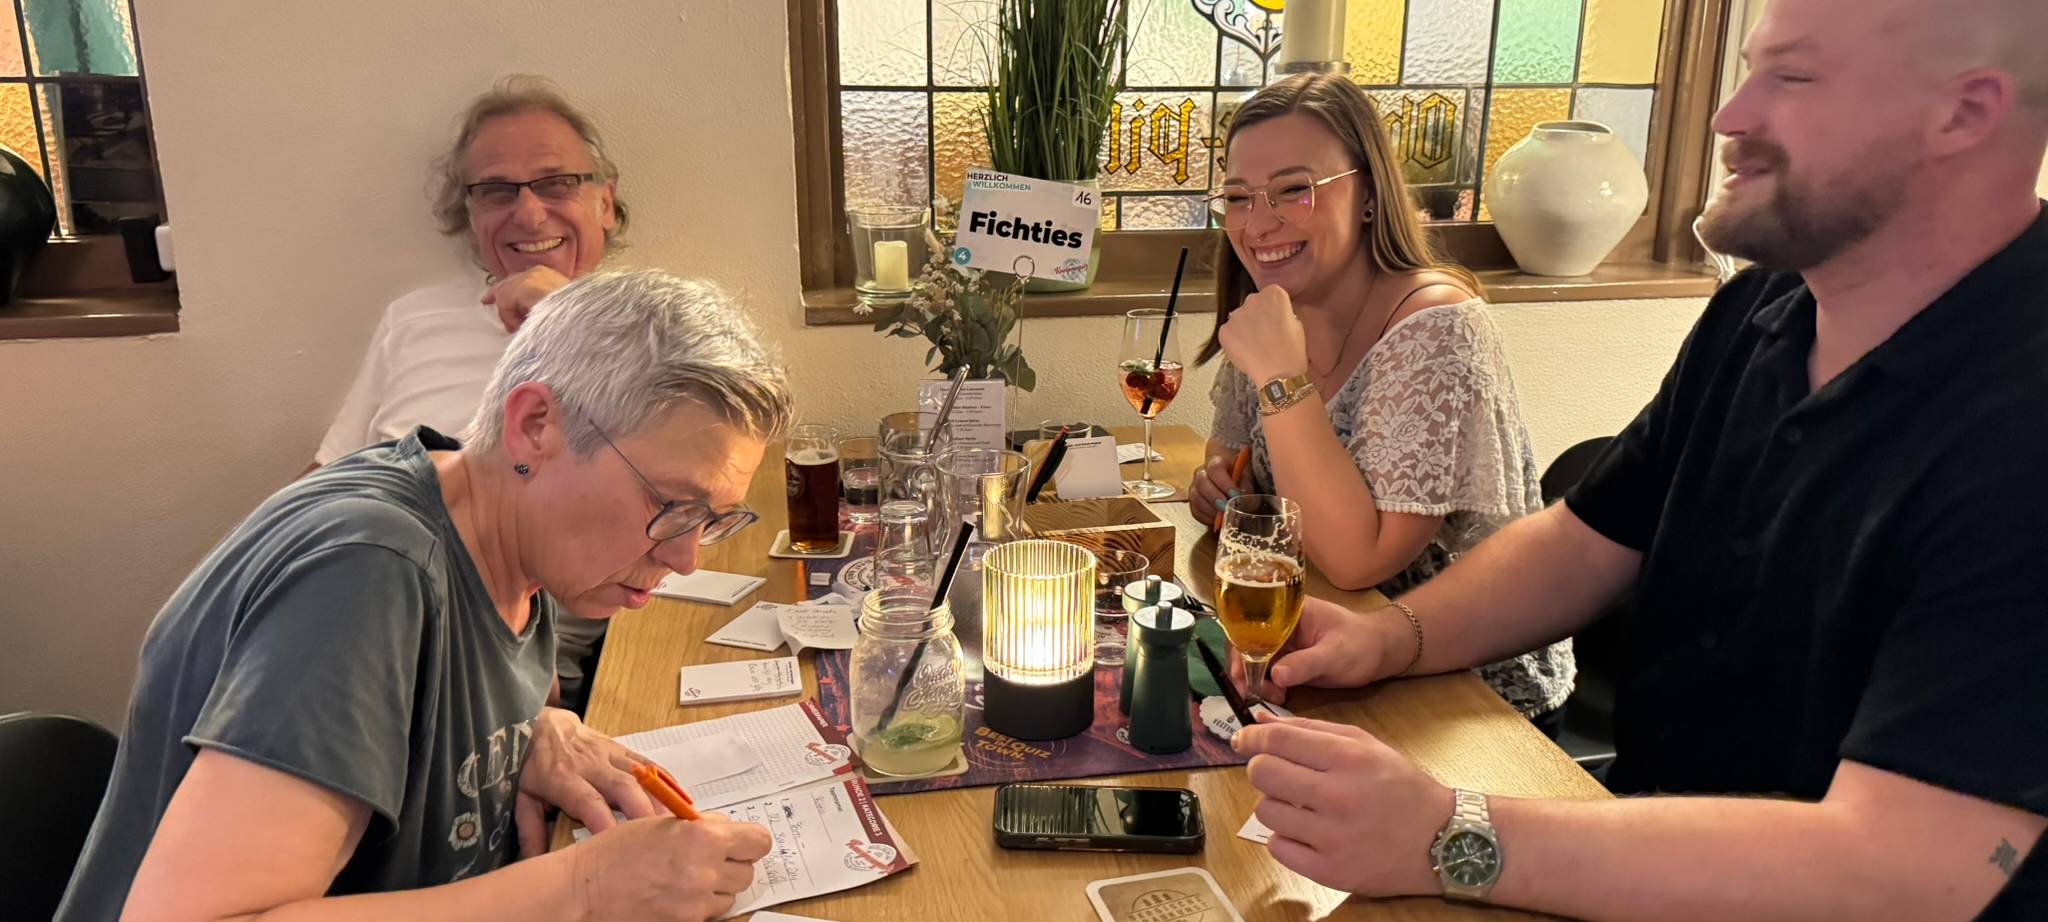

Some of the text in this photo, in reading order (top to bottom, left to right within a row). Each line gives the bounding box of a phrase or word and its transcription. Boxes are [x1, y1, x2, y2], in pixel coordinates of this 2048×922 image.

[966, 172, 1008, 182] HERZLICH
[972, 180, 1031, 191] WILLKOMMEN
[1075, 190, 1092, 205] 16
[969, 210, 1083, 249] Fichties
[958, 250, 967, 261] 4
[1012, 741, 1051, 759] QUIZ
[851, 779, 864, 797] RUNDE
[862, 804, 881, 832] KATEGORIE
